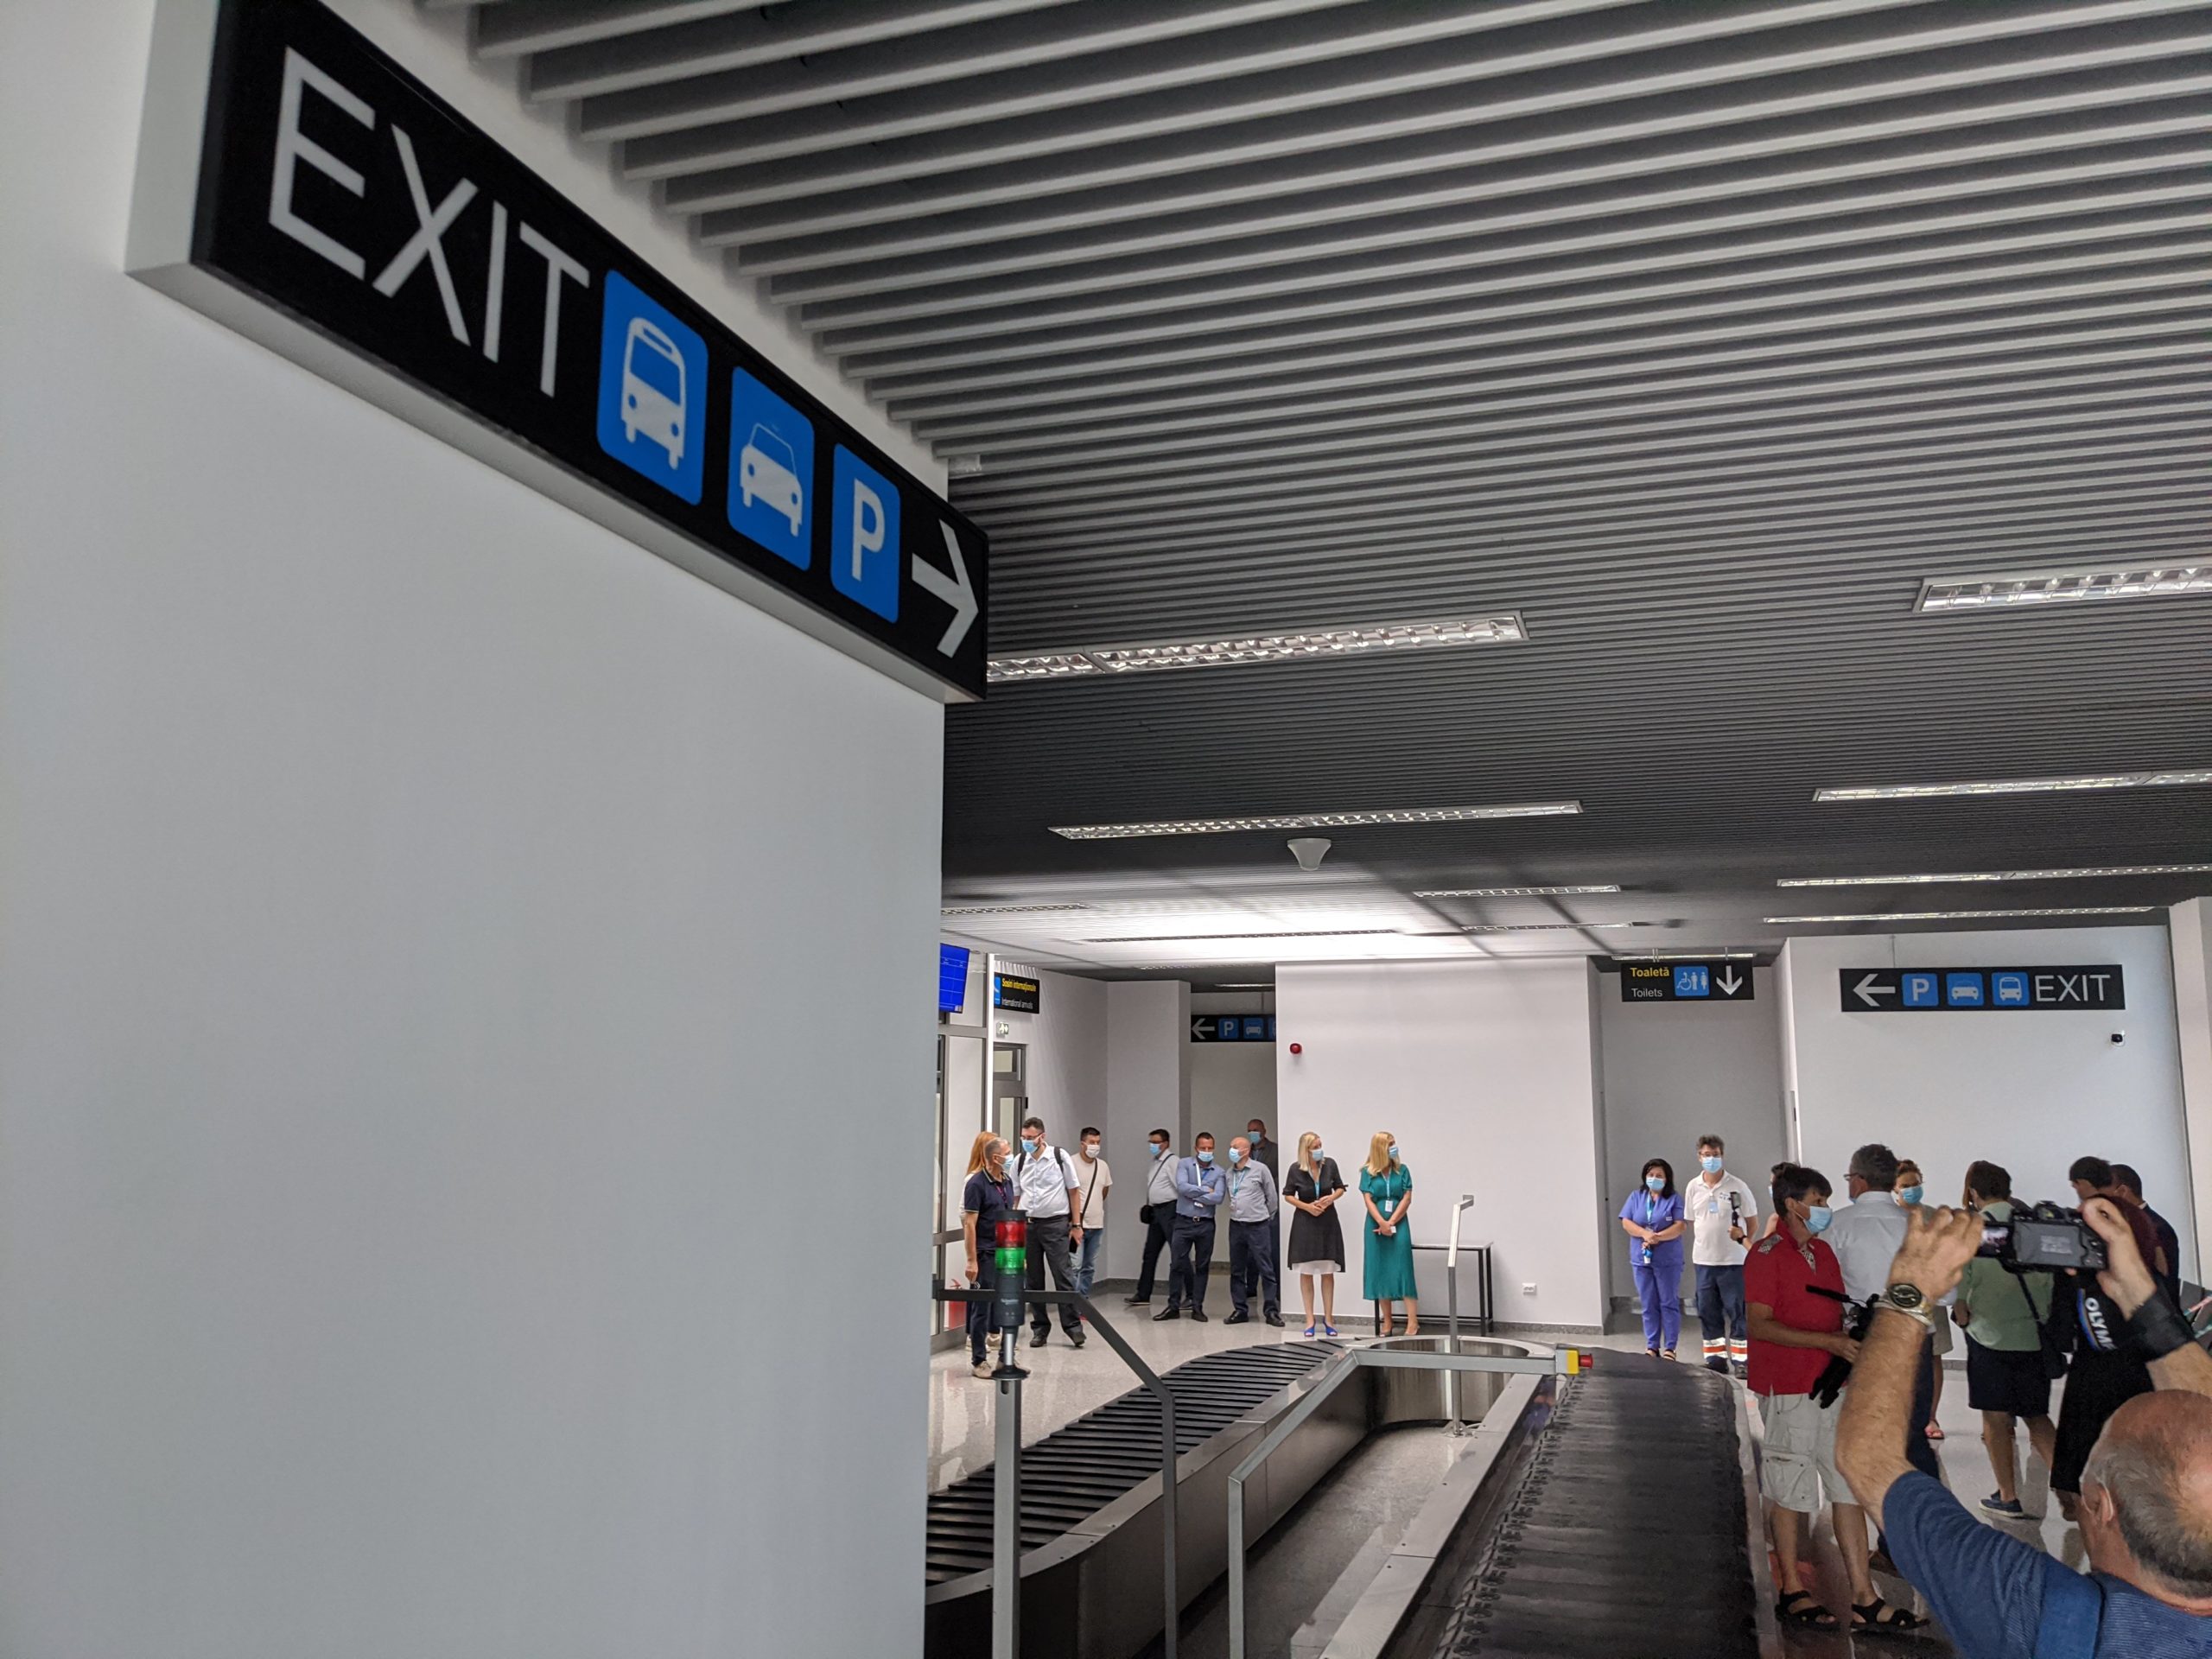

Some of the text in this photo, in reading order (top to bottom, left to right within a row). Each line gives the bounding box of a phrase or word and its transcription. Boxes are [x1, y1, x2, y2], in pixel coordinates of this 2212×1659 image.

[269, 45, 887, 582] EXIT P
[1630, 966, 1670, 977] Toaletă
[1631, 988, 1663, 998] Toilets
[1911, 974, 2111, 1002] P EXIT
[1224, 1021, 1234, 1036] P
